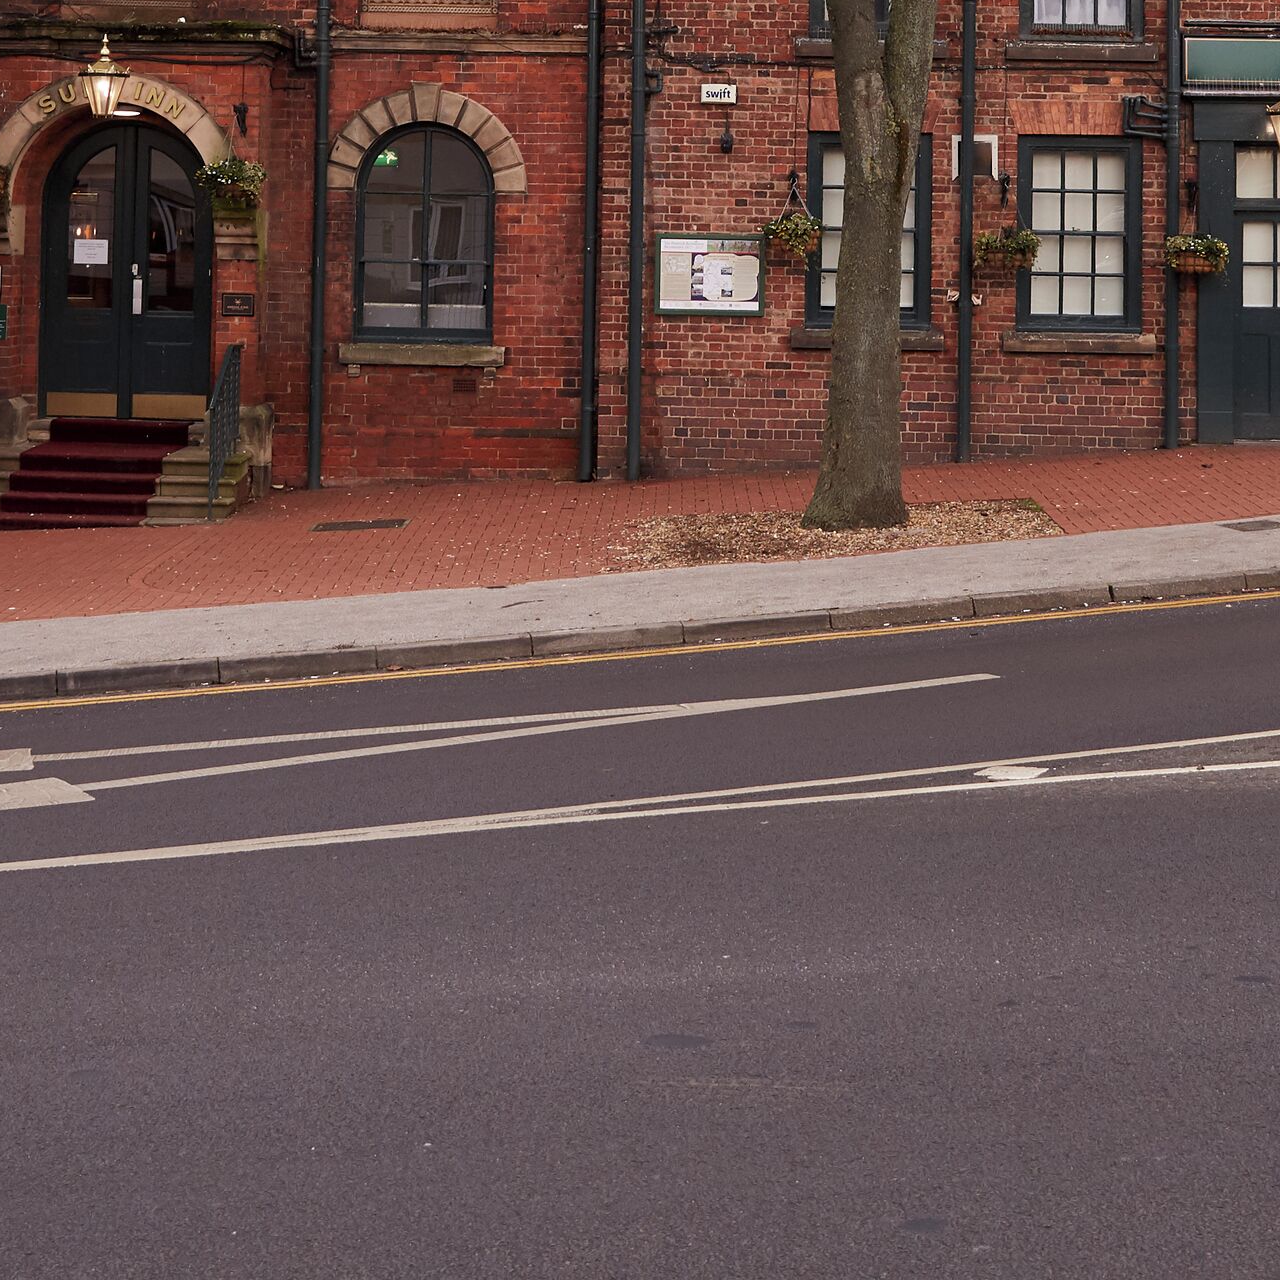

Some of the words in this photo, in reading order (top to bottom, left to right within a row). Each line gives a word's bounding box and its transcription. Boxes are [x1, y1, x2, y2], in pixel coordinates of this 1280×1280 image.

[38, 81, 89, 114] SU
[134, 81, 186, 120] INN
[705, 87, 731, 99] swift
